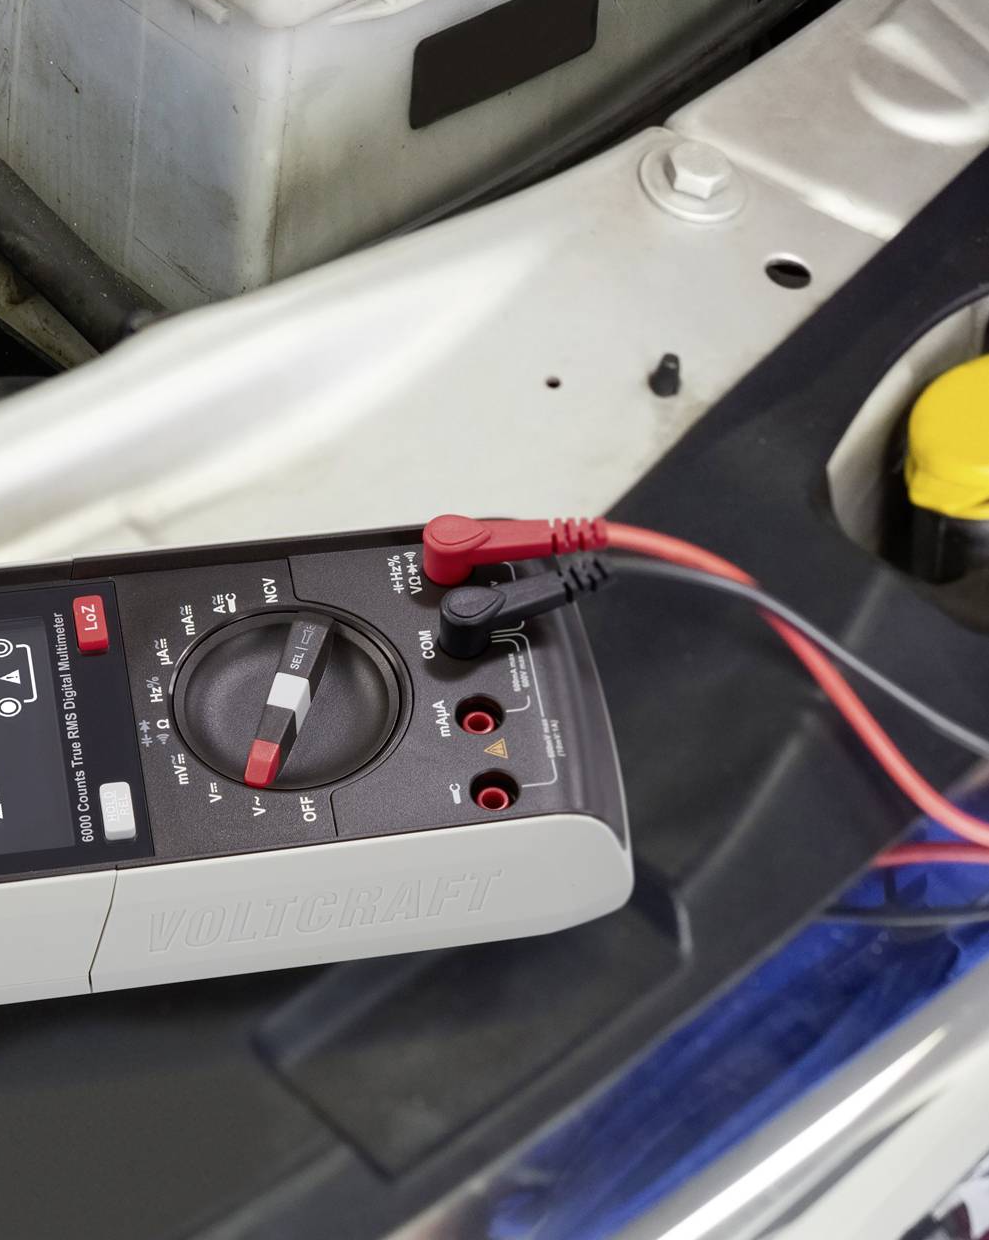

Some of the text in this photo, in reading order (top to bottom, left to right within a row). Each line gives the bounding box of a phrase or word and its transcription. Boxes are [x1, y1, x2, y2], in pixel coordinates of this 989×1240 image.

[262, 578, 278, 603] NCV
[81, 604, 98, 631] LoZ
[419, 630, 436, 659] COM
[290, 653, 304, 670] SEL
[52, 612, 95, 842] 6000 Counts True RMS Digital Multimeter
[104, 791, 117, 822] HOLD
[119, 794, 129, 815] REL
[300, 796, 318, 822] OFF
[148, 869, 502, 953] VOLTCRAFT
